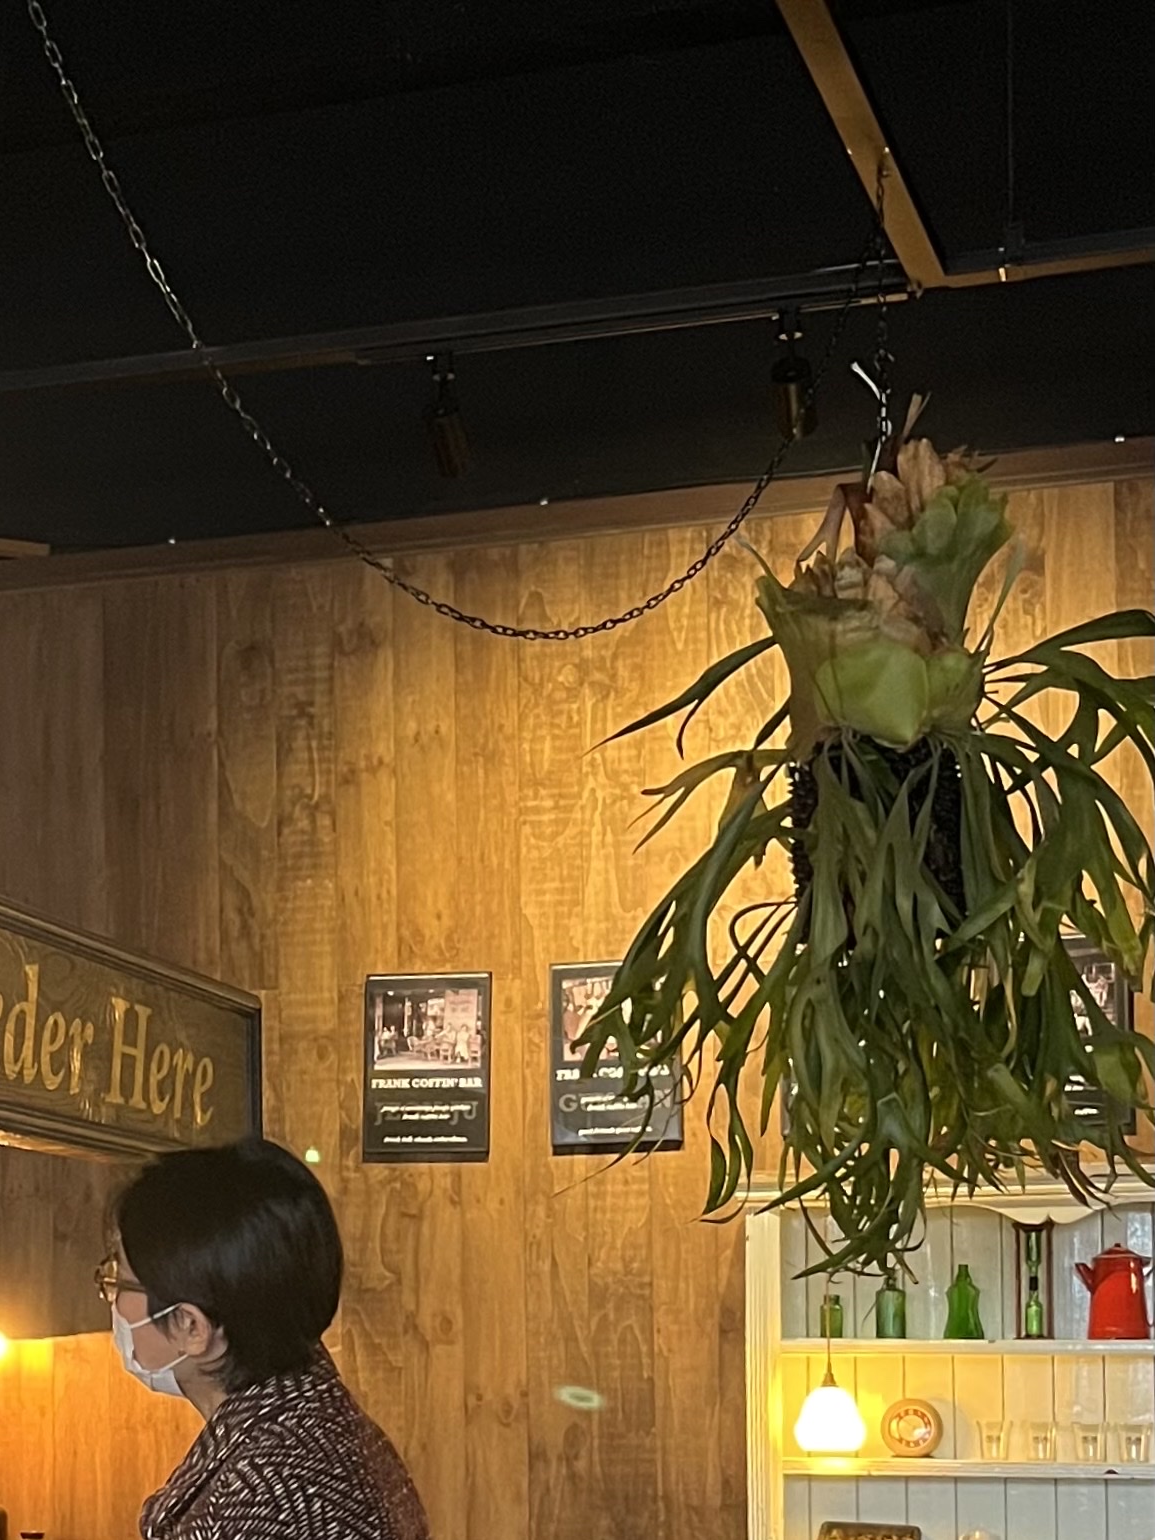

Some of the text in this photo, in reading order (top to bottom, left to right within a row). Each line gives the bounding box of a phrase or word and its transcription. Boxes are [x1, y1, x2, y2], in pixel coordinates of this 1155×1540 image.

[104, 996, 215, 1127] Here
[371, 1076, 483, 1090] FRANK COFFIN' BAR
